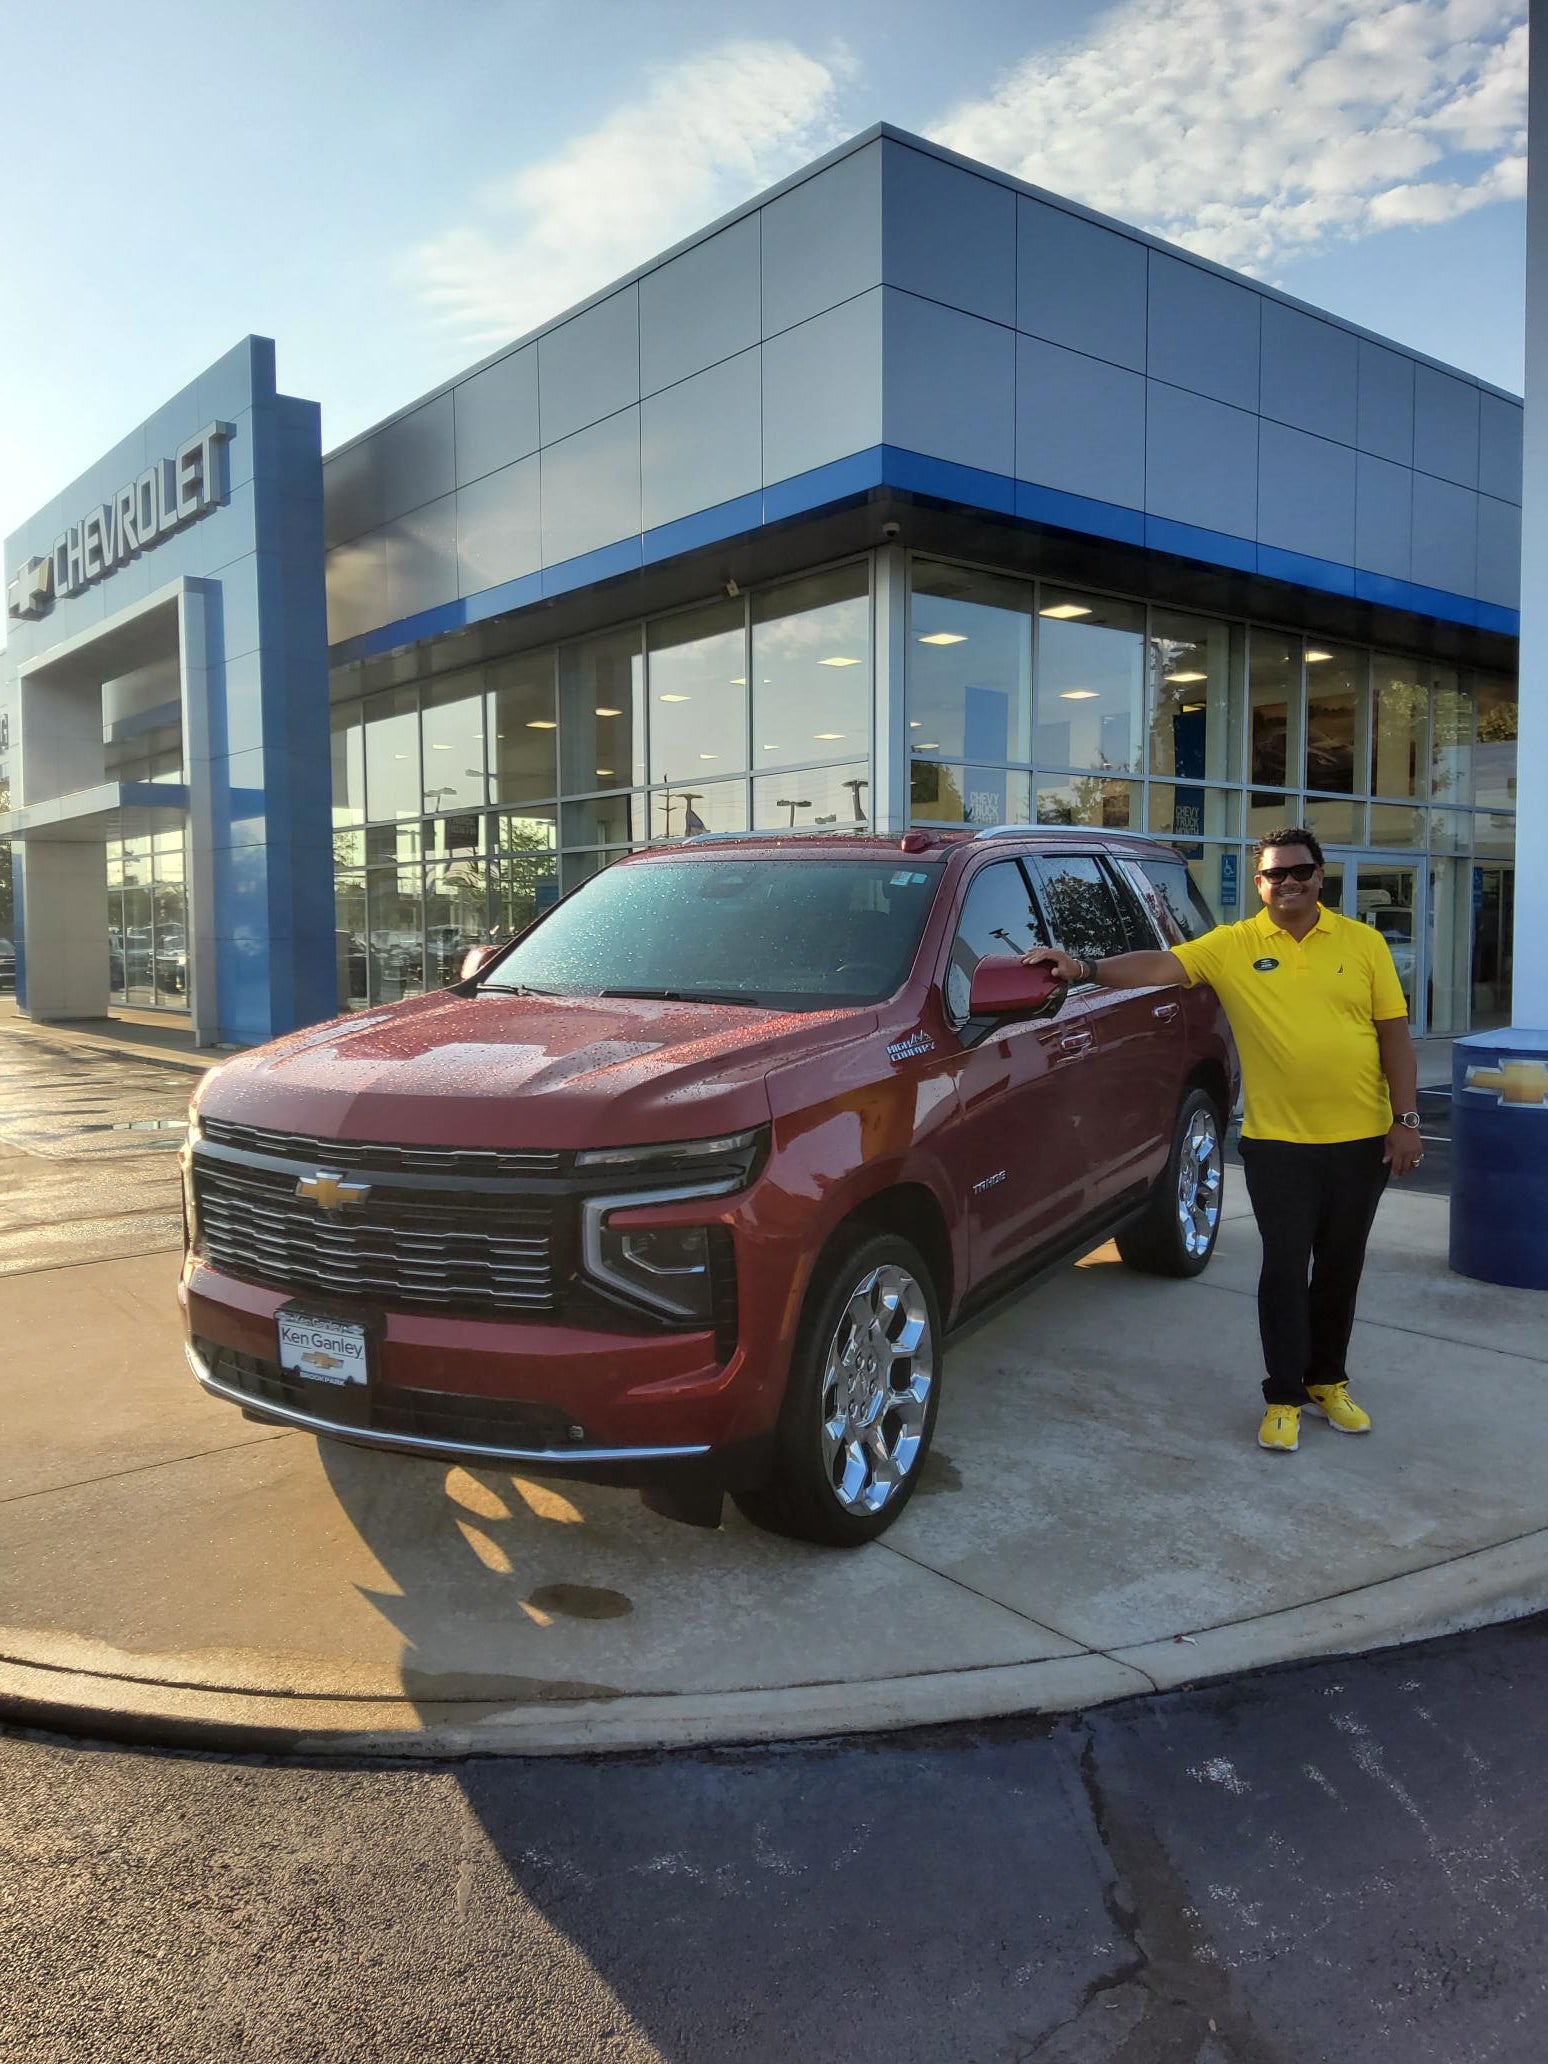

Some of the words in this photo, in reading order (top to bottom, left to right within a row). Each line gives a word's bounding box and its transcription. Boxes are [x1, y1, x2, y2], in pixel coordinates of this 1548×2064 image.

[53, 420, 222, 598] CHEVROLET
[970, 792, 1000, 804] CHEVY
[970, 804, 999, 816] TRUCK
[1176, 806, 1200, 817] CHEVY
[1175, 817, 1199, 827] TRUCK
[886, 1040, 912, 1054] HIGH
[891, 1041, 935, 1062] COUNTRY
[972, 1170, 1006, 1195] TAHOE
[281, 1327, 309, 1345] Ken
[311, 1333, 363, 1360] Ganley
